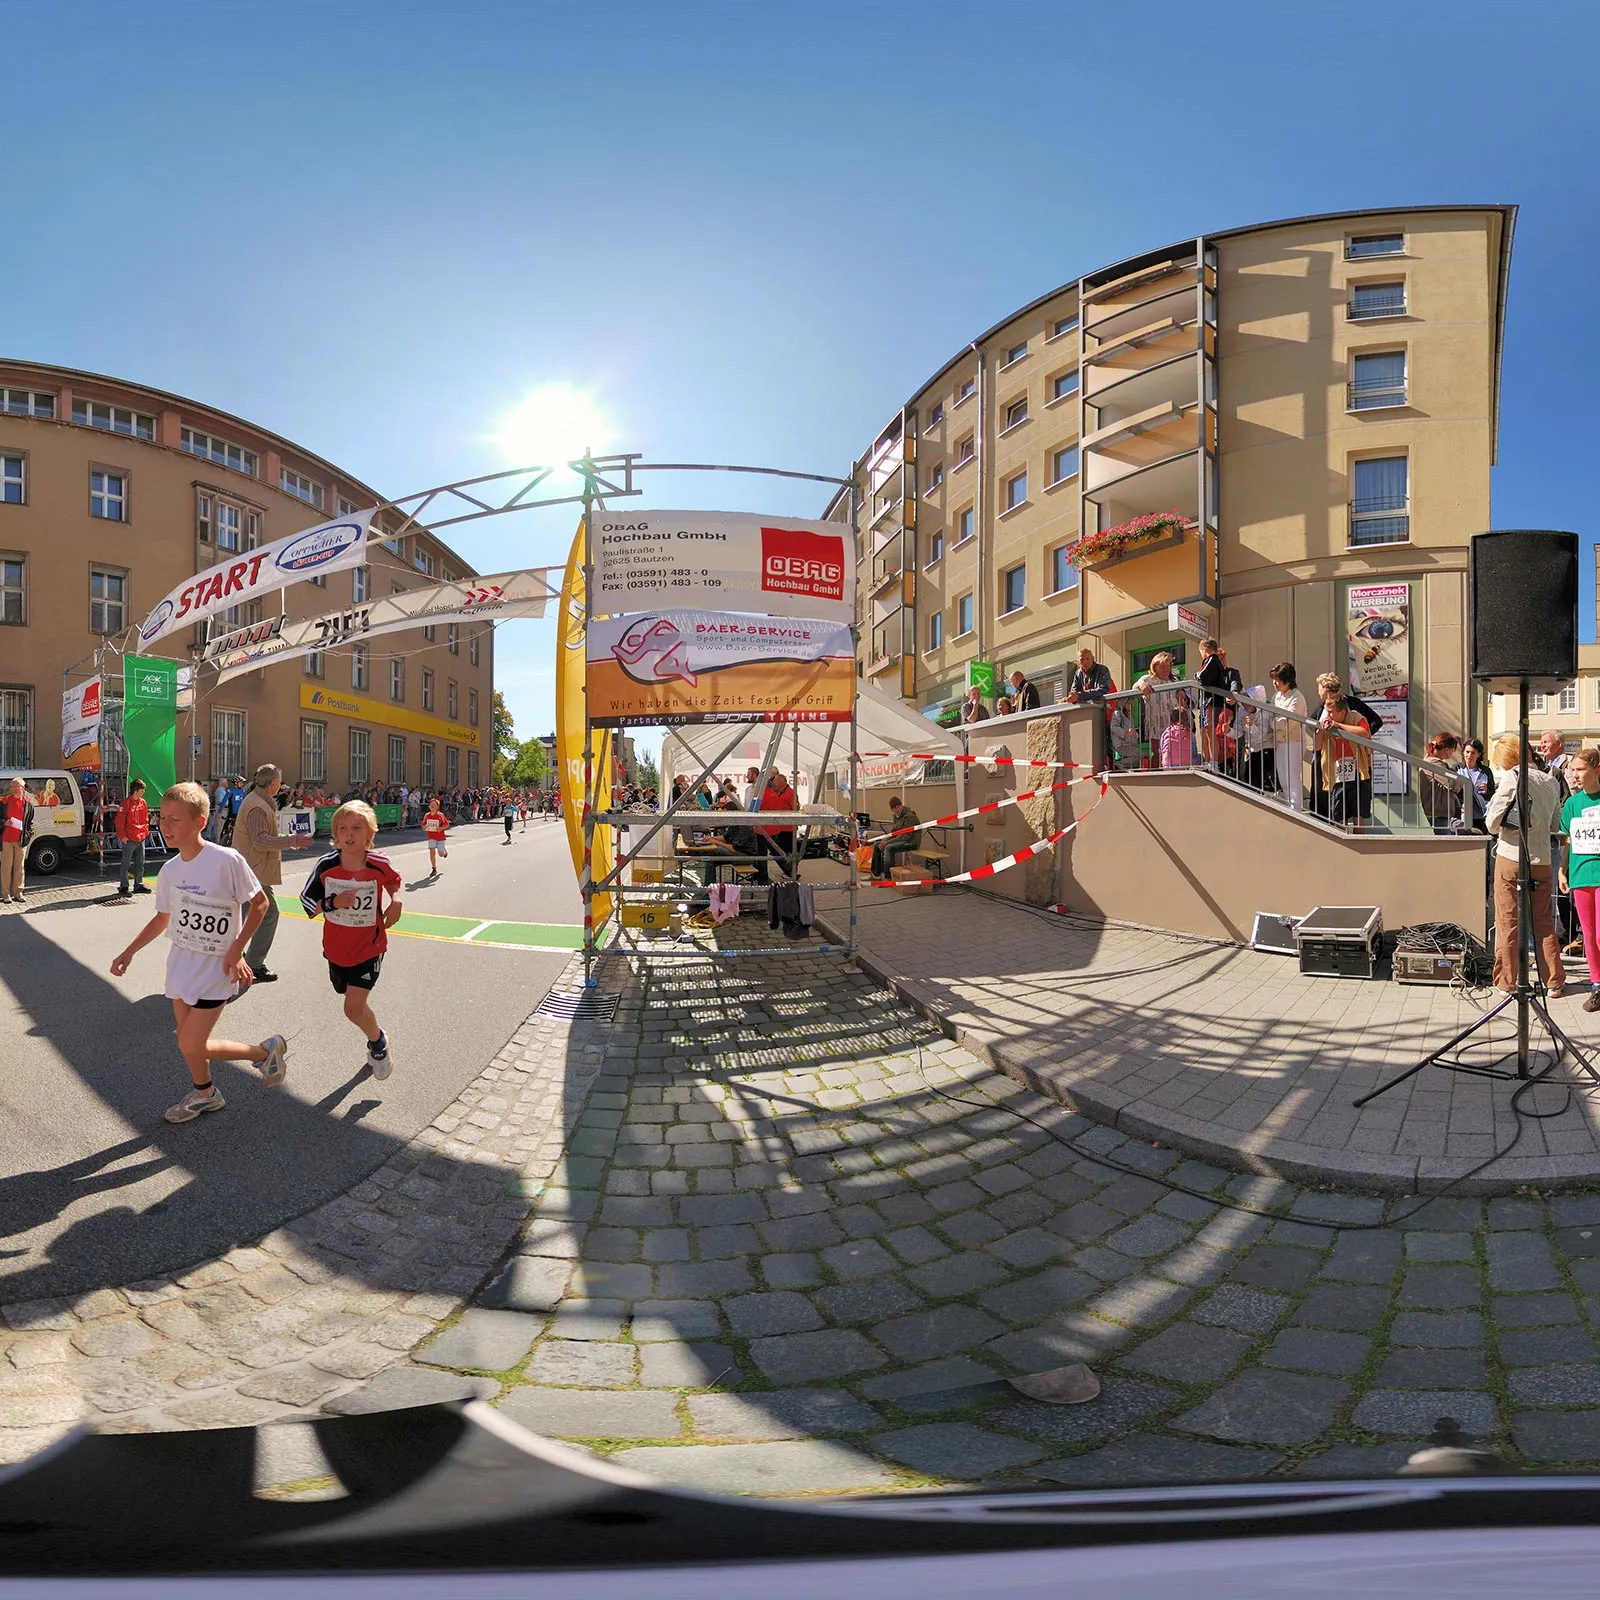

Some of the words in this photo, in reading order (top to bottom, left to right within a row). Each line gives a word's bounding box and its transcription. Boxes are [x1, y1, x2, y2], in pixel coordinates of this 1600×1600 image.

[602, 522, 649, 532] OBAG
[602, 532, 671, 545] Hochbau
[677, 531, 727, 541] GmbH
[603, 557, 631, 568] 02625
[626, 569, 667, 580] (03591)
[766, 555, 841, 583] OBAG
[175, 552, 271, 618] START
[602, 582, 623, 591] Fax:
[627, 580, 667, 590] (03591)
[671, 579, 691, 587] 483
[702, 579, 722, 587] 109
[766, 578, 810, 591] Hochbau
[812, 583, 840, 596] GmbH
[1351, 586, 1405, 598] Morczinek
[1351, 596, 1405, 608] WERBUNG
[696, 624, 812, 640] BAER-SERVICE
[696, 635, 729, 643] Sport-
[142, 675, 162, 685] AOK
[141, 685, 162, 693] PLUS
[327, 696, 360, 713] Postbank
[610, 700, 633, 710] Wir
[639, 698, 679, 709] haben
[685, 696, 707, 706] die
[713, 695, 744, 706] Zeit
[750, 695, 780, 705] fest
[785, 695, 801, 705] im
[806, 695, 834, 705] Griff
[619, 716, 664, 725] Partner
[667, 715, 687, 724] von
[702, 712, 766, 723] SPORT
[768, 712, 829, 722] TIMING
[296, 822, 309, 831] EWB
[179, 909, 229, 935] 3380
[639, 912, 655, 924] 16
